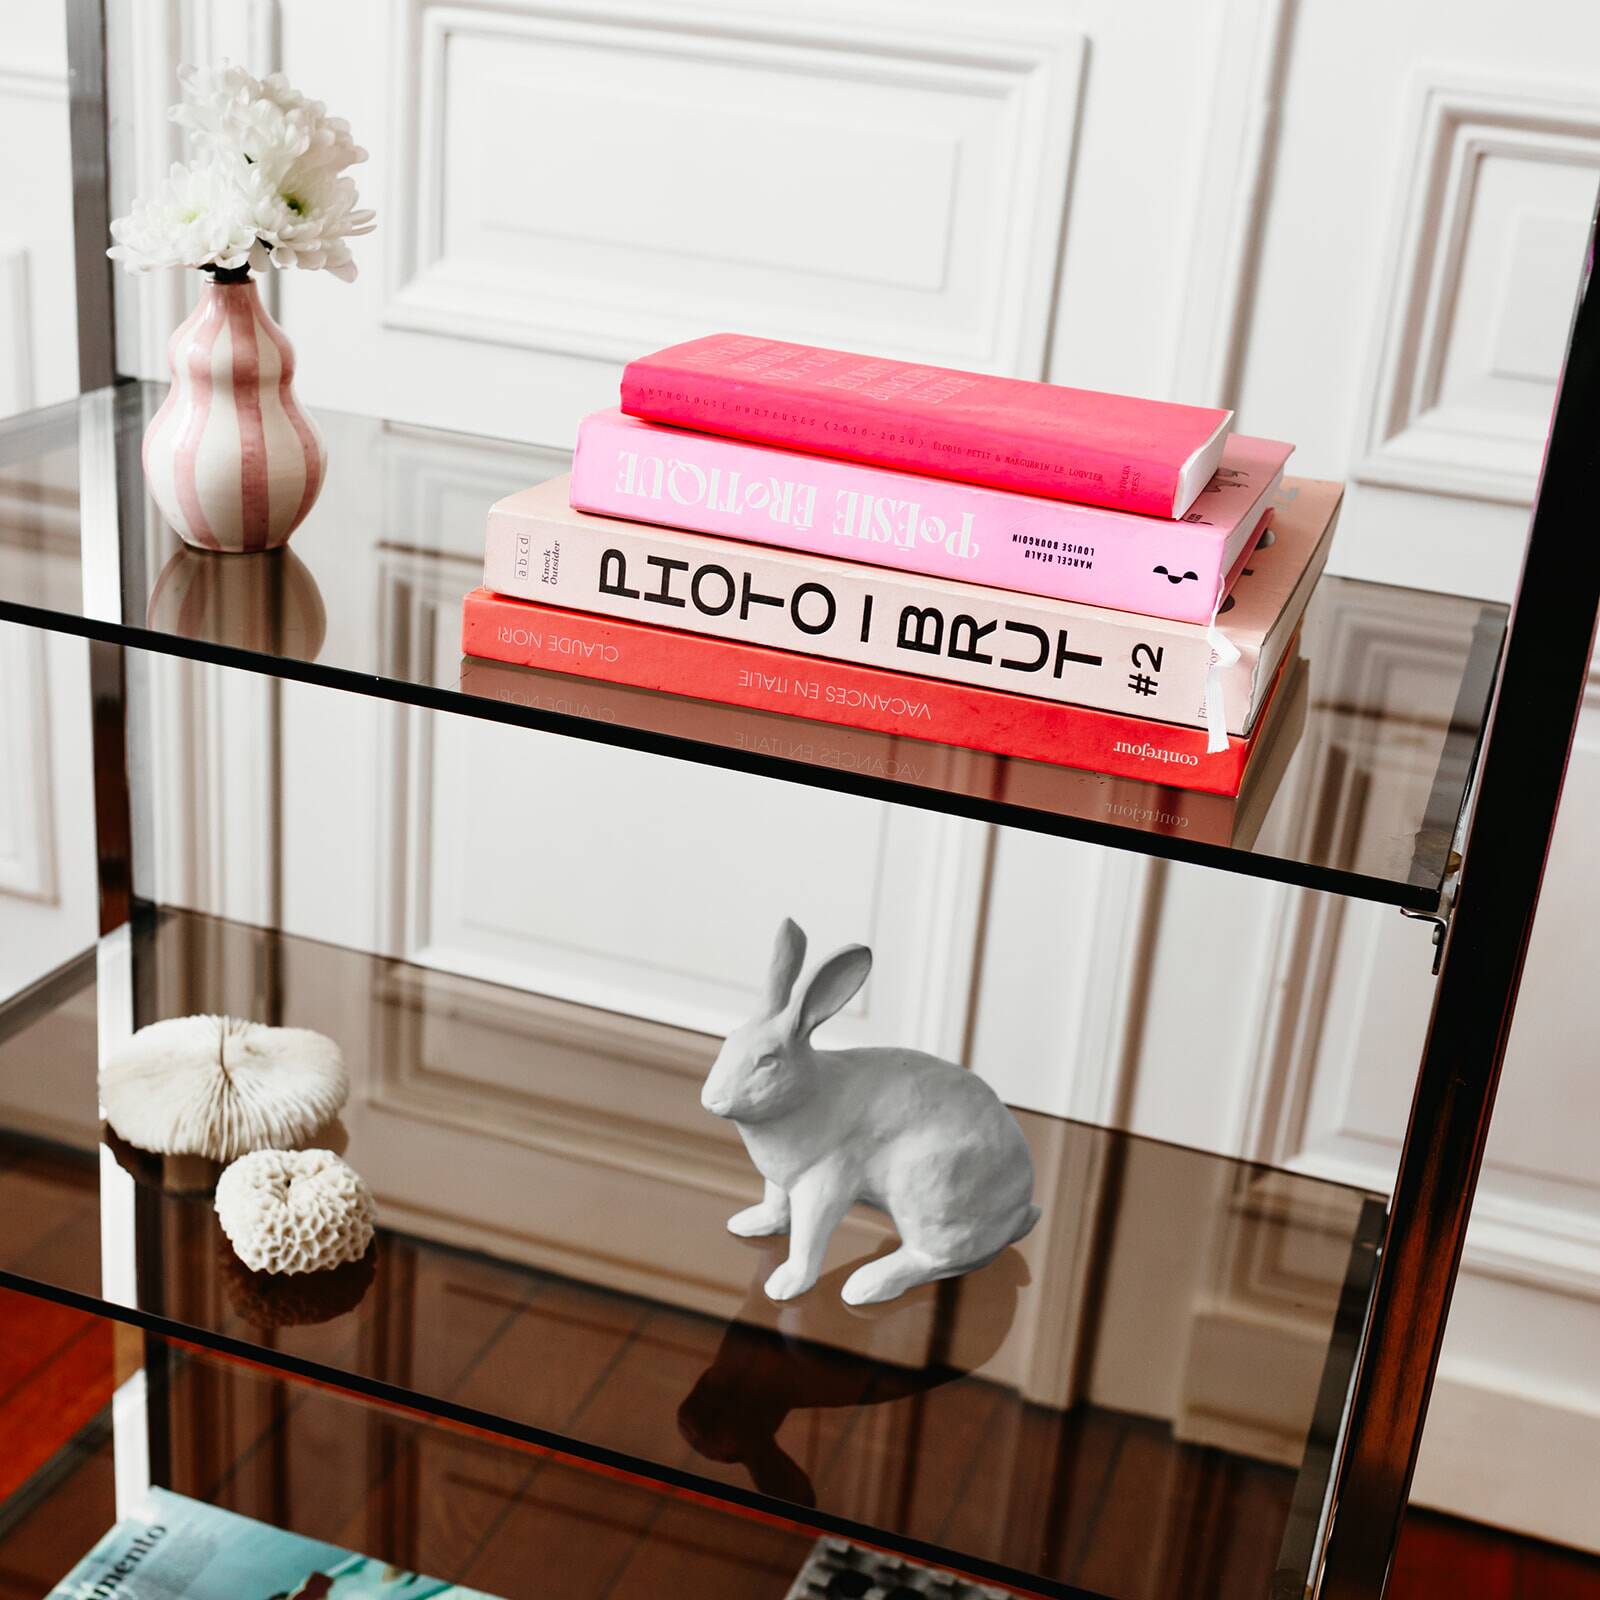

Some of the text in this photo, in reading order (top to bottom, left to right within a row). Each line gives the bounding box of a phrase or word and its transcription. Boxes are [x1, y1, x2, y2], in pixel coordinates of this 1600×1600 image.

[638, 387, 728, 410] ANTHOLOGIE
[824, 420, 924, 449] (2010-2020)
[966, 448, 990, 460] PETIT
[1054, 465, 1064, 474] LE
[550, 540, 560, 585] Outsider
[1012, 533, 1095, 557] LOUISE BOURGOIN
[1057, 555, 1093, 570] MARCEL
[541, 549, 551, 584] Knock
[497, 624, 620, 663] CLAUDE NORI
[598, 548, 837, 636] PHOTO
[896, 604, 1103, 680] BRUT
[1127, 642, 1165, 697] #2
[738, 670, 932, 721] VACANCES EN ITALIE
[1112, 741, 1199, 767] contrejour
[86, 1525, 167, 1600] mento
